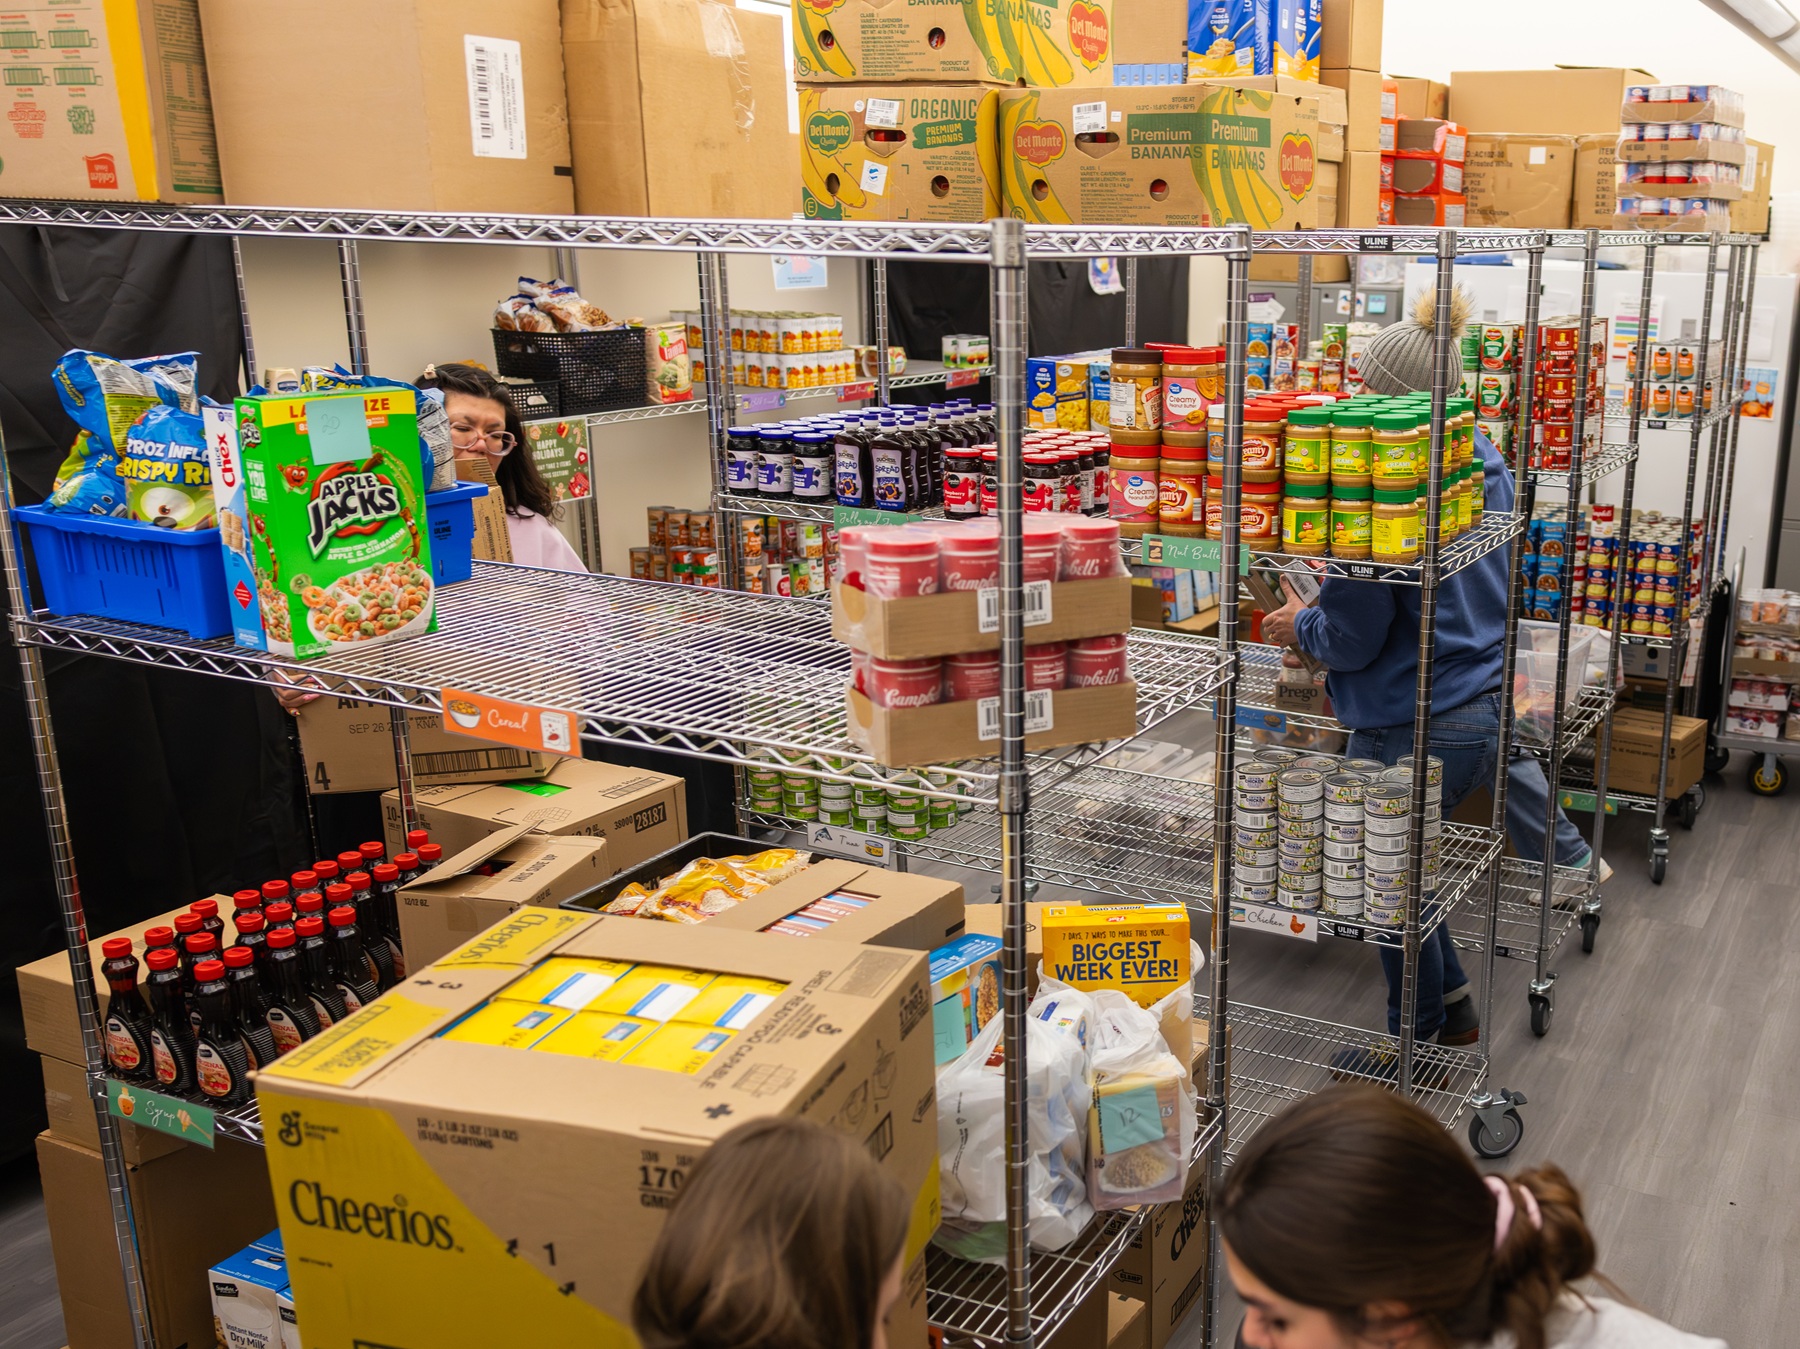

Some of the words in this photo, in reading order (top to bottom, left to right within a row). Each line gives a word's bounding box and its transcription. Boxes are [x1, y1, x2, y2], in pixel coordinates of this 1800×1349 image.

[985, 2, 1051, 29] BANANAS
[1072, 17, 1084, 34] Del
[1085, 21, 1108, 42] Monte
[910, 99, 977, 119] ORGANIC
[810, 124, 822, 136] Del
[823, 124, 849, 137] Monte
[926, 123, 962, 134] PREMIUM
[1131, 128, 1191, 141] Premium
[1212, 119, 1258, 142] Premium
[926, 133, 963, 146] BANANAS
[1016, 135, 1031, 147] Del
[1032, 136, 1062, 147] Monte
[1131, 146, 1203, 160] BANANAS
[1212, 149, 1265, 171] BANANAS
[1281, 154, 1290, 170] Del
[1291, 155, 1312, 172] Monte
[90, 173, 115, 183] Golden
[1364, 237, 1388, 246] ULINE
[364, 398, 390, 411] IZE
[1169, 395, 1196, 404] Creamy
[536, 439, 557, 450] HAPPY
[217, 433, 235, 488] Chex
[532, 448, 564, 460] HOLIDAYS!
[124, 457, 178, 482] RISPY
[837, 460, 857, 469] SPREAD
[875, 464, 899, 474] SPREAD
[322, 475, 376, 500] APPLE
[1128, 488, 1156, 497] Creamy
[309, 487, 396, 548] JACKS
[839, 510, 862, 526] Jelly
[327, 551, 352, 560] APPLE
[365, 528, 405, 554] CINNAMON
[1167, 545, 1189, 558] Nut
[1192, 546, 1232, 560] Butte
[1351, 566, 1374, 575] ULINE
[1279, 685, 1318, 702] Prego
[349, 724, 370, 734] SEP
[372, 723, 385, 732] 26
[416, 720, 438, 729] KNA
[486, 710, 528, 732] Cereal
[314, 762, 331, 791] 4
[614, 815, 633, 830] 38000
[634, 804, 664, 831] 28187
[839, 835, 860, 848] Tuna
[510, 870, 527, 883] THIS
[528, 860, 545, 874] SIDE
[546, 854, 558, 865] UP
[1247, 906, 1284, 928] Chicken
[459, 913, 548, 960] Cheerios
[1068, 932, 1083, 940] DAYS,
[1338, 926, 1359, 936] ULINE
[1072, 941, 1161, 962] BIGGEST
[1055, 962, 1113, 982] WEEK
[1121, 959, 1178, 979] EVER!
[800, 969, 832, 995] SHELF
[702, 1045, 753, 1089] CAPABLE
[145, 1100, 175, 1127] Syrup
[1120, 1108, 1140, 1128] 12
[304, 1122, 340, 1134] General
[450, 1134, 495, 1149] CARTONS
[1183, 1182, 1201, 1215] Rice
[290, 1179, 455, 1252] Cheerios
[1170, 1192, 1205, 1261] Chex
[543, 1242, 556, 1266] 1
[226, 1323, 248, 1335] Instant
[248, 1330, 269, 1342] Nonfat
[230, 1332, 245, 1346] Dry
[247, 1337, 266, 1349] Milk
